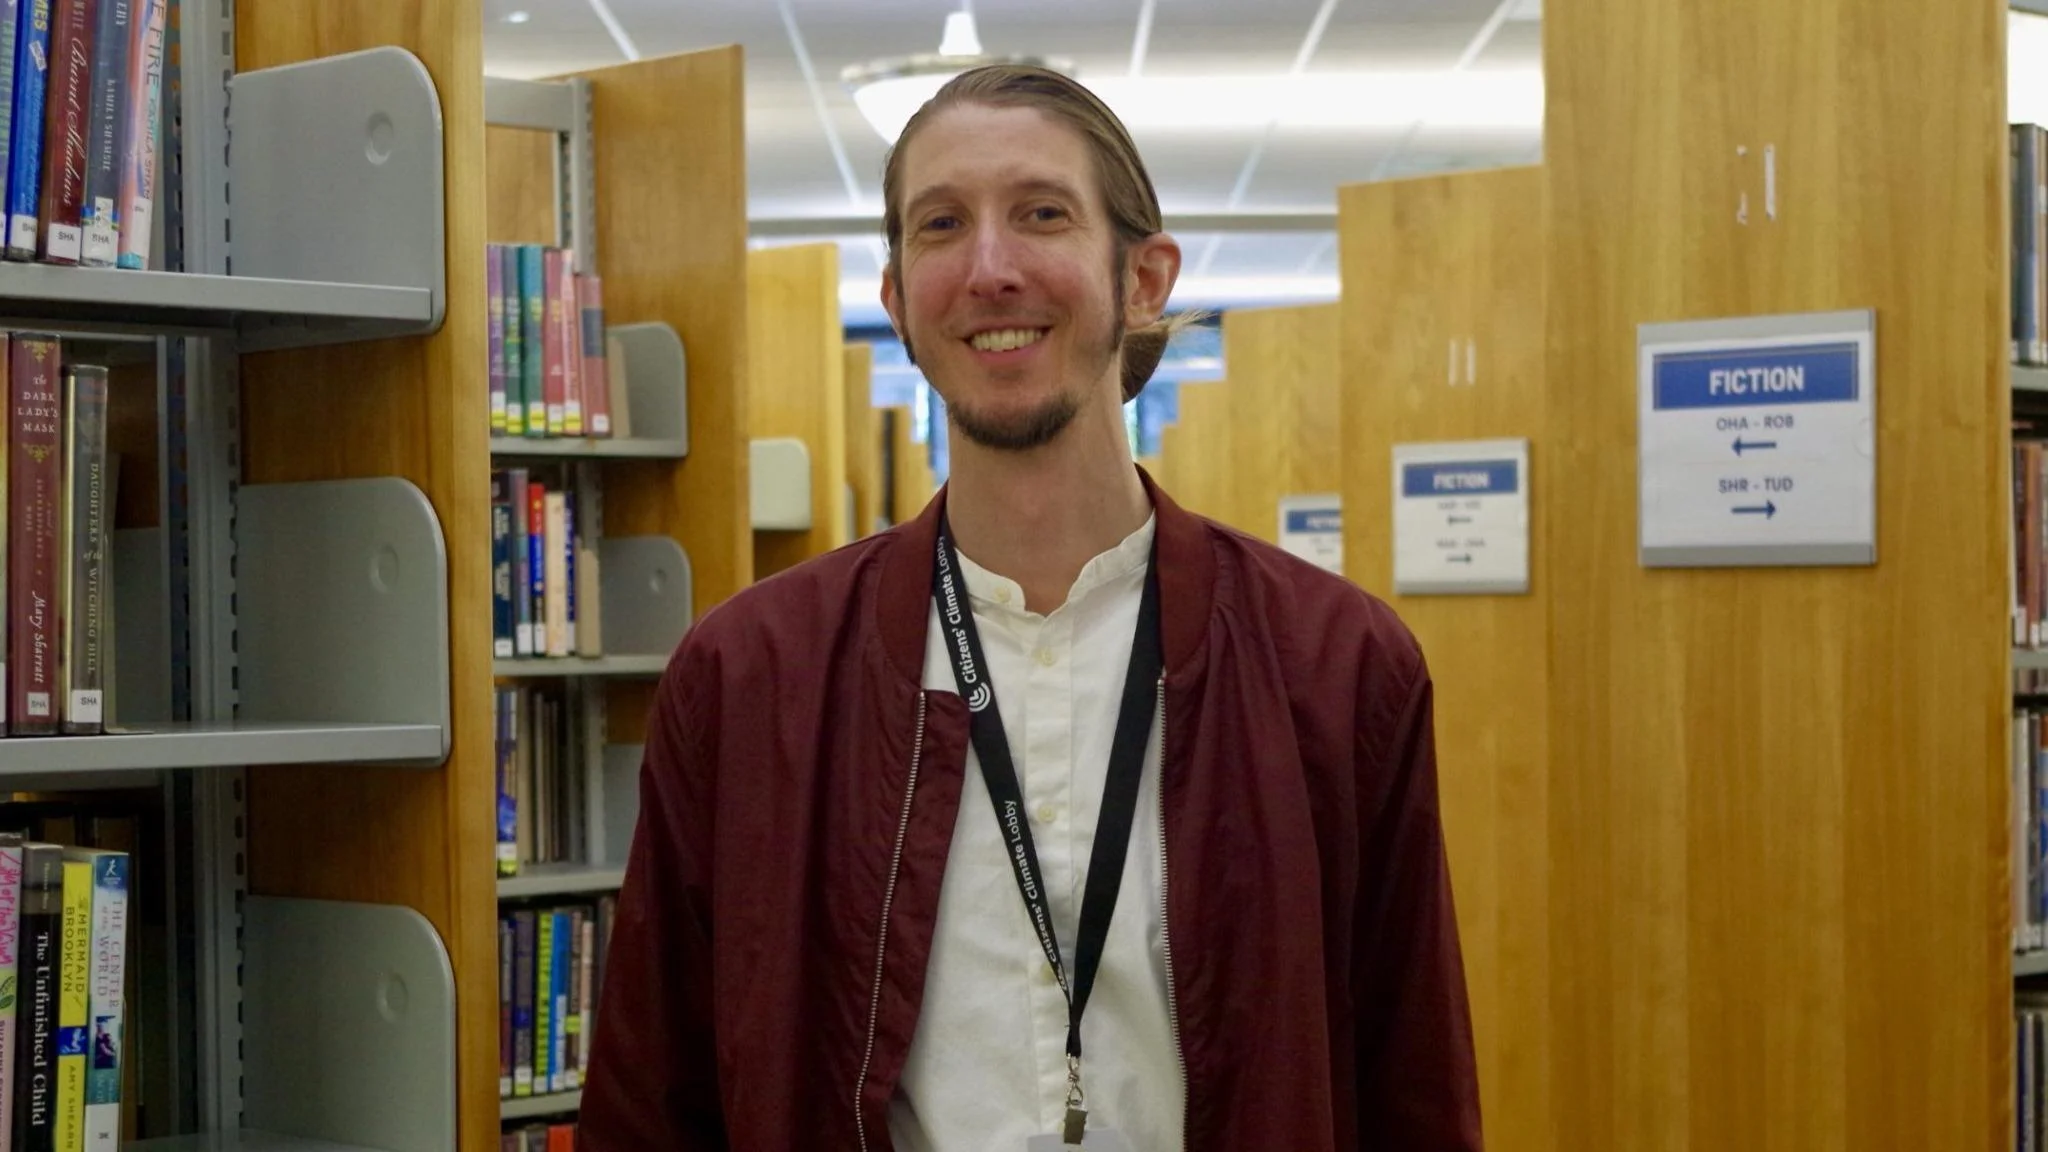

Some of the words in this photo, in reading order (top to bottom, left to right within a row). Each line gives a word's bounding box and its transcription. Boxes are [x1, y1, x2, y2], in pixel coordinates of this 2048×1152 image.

[66, 37, 88, 109] Burnt
[147, 27, 162, 87] FIRE
[64, 110, 87, 207] Shadows
[58, 231, 75, 242] SHA
[23, 391, 55, 402] DARK
[1709, 366, 1804, 395] FICTION
[17, 407, 58, 418] LADY'S
[23, 423, 56, 433] MASK
[1716, 417, 1749, 431] OHA
[1763, 415, 1794, 429] ROB
[90, 463, 99, 543] DAUGHTERS
[1433, 472, 1490, 490] FICTION
[1718, 479, 1749, 493] SHR
[1763, 477, 1794, 491] TUD
[29, 589, 47, 630] Mary
[88, 567, 98, 637] WITCHING
[942, 574, 962, 625] Climate
[34, 632, 47, 684] Sharratt
[87, 640, 96, 674] HILL
[952, 628, 977, 684] Citizens'
[80, 697, 97, 706] SHA
[1004, 799, 1022, 841] Lobby
[1015, 844, 1039, 900] Climate
[112, 900, 123, 931] THE
[1032, 903, 1057, 963] Citizens'
[36, 932, 48, 961] The
[63, 906, 75, 992] BROOKLYN
[75, 913, 87, 993] MERMAID
[98, 936, 109, 997] WORLD
[109, 940, 120, 1009] CENTER
[34, 965, 50, 1067] Unfinished
[32, 1073, 46, 1126] Child
[69, 1065, 77, 1092] AMY
[66, 1097, 76, 1149] SHEARN
